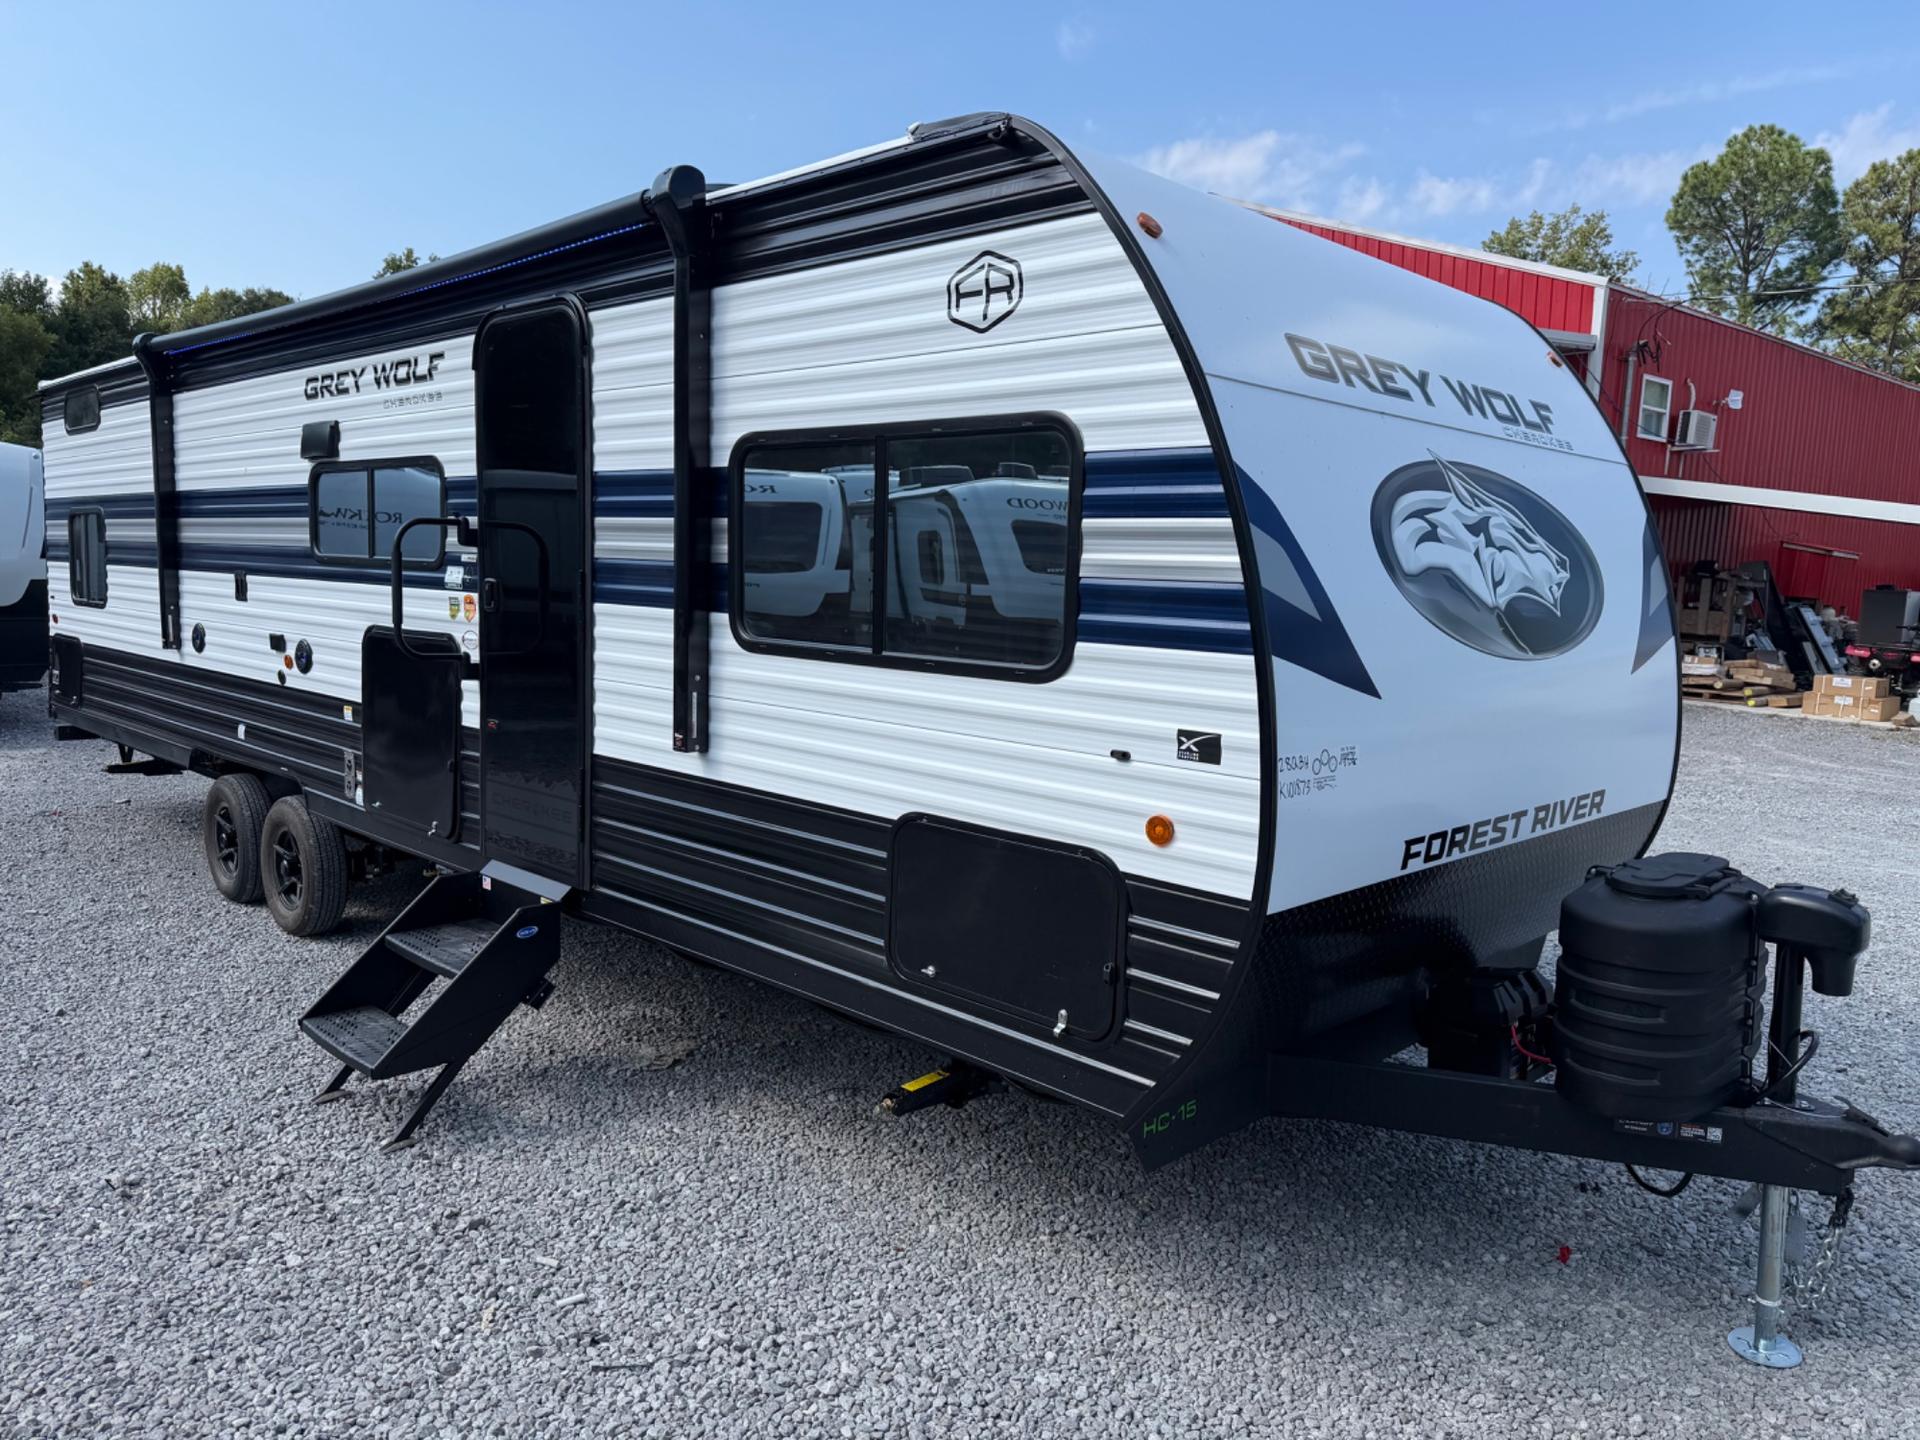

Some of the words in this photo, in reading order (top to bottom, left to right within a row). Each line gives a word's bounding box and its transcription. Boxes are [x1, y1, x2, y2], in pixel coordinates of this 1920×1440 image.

[304, 367, 366, 400] GREY
[373, 351, 446, 389] WOLF
[1284, 332, 1436, 407] GREY
[1439, 375, 1554, 435] WOLF
[1400, 809, 1529, 870] FOREST
[1530, 789, 1606, 833] RIVER
